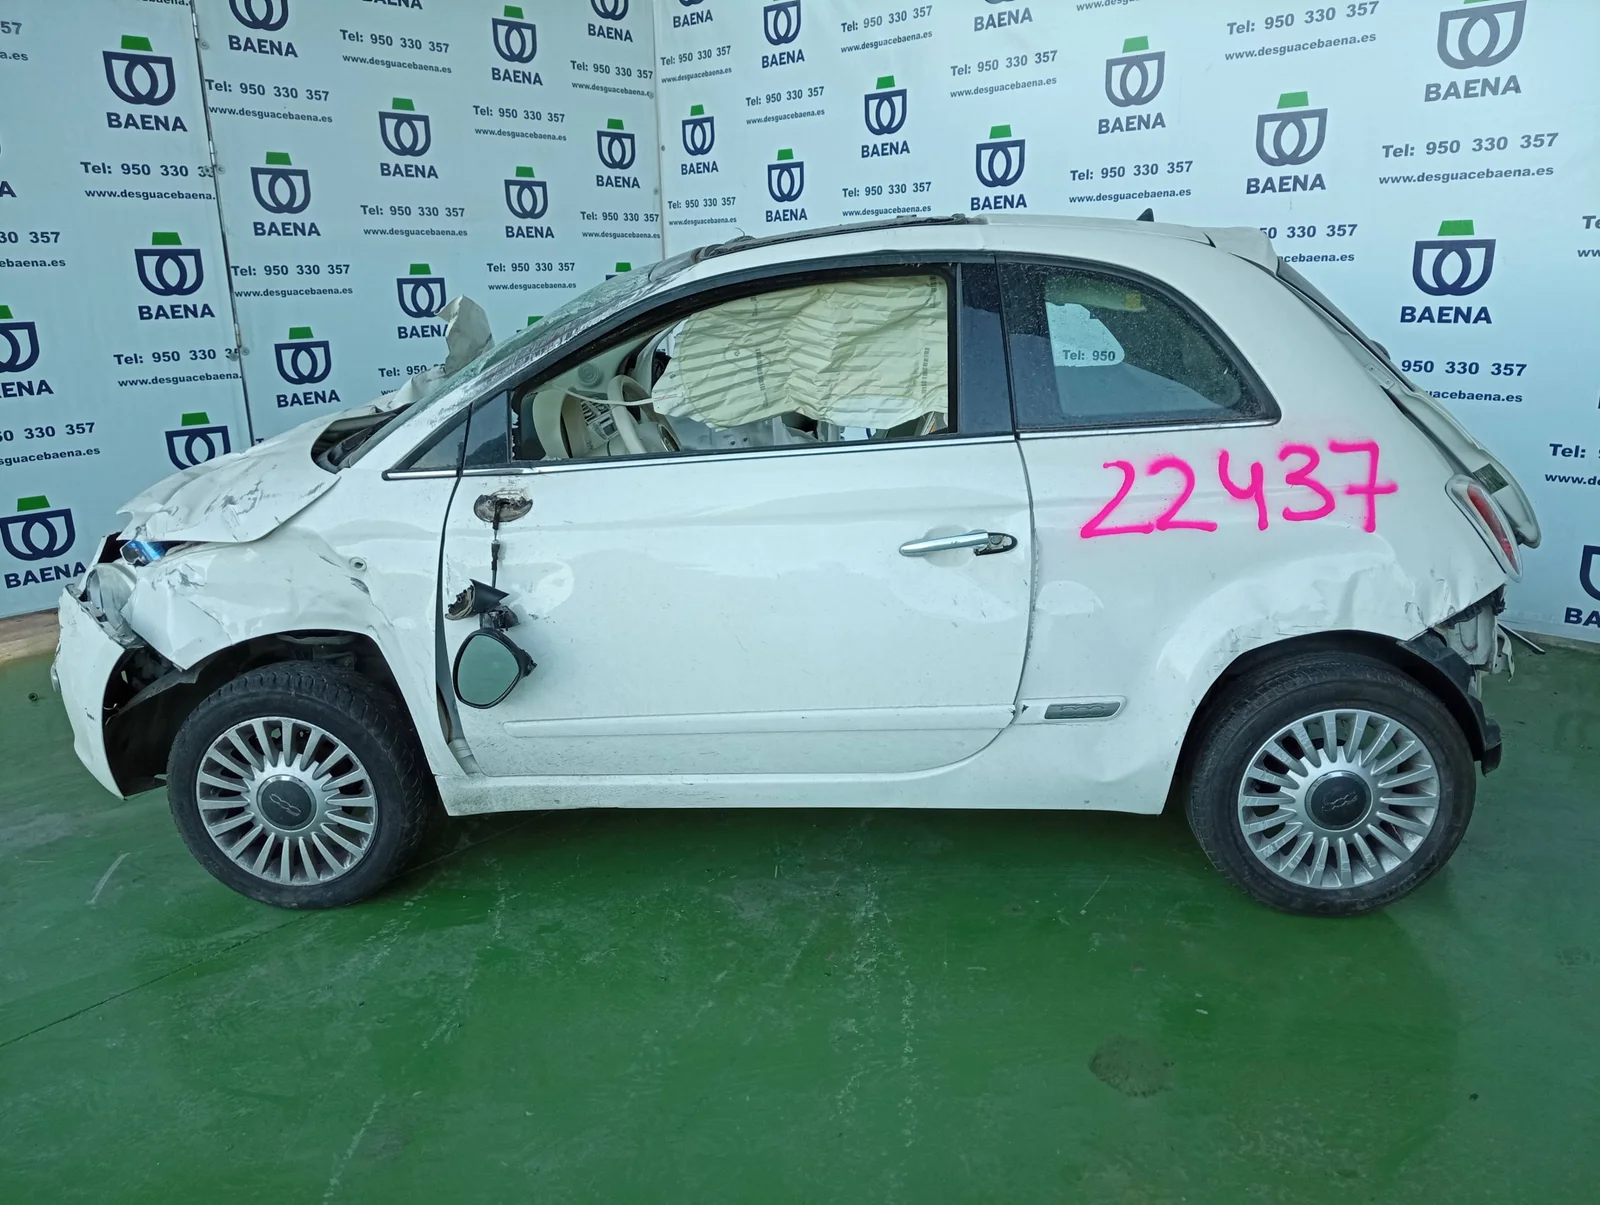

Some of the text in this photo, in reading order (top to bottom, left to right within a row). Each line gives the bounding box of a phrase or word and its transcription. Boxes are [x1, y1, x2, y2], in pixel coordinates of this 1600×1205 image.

[673, 10, 713, 28] BAENA
[841, 5, 932, 32] Tel: 950 330 357
[974, 8, 1033, 31] BAENA
[1227, 1, 1379, 35] Tel: 950 330 357
[588, 23, 633, 42] BAENA
[228, 35, 298, 57] BAENA
[340, 29, 449, 53] Tel: 950 330 357
[841, 30, 932, 53] www.desguacebaena.es
[1225, 32, 1376, 60] www.desguacebaena.es
[660, 45, 731, 65] Tel: 950 330 357
[762, 49, 805, 68] BAENA
[951, 50, 1057, 76] Tel: 950 330 357
[342, 55, 451, 73] www.desguacebaena.es
[570, 60, 653, 79] Tel: 950 330 357
[492, 67, 543, 85] BAENA
[661, 68, 731, 83] www.desguacebaena.es
[205, 79, 329, 101] Tel: 950 330 357
[950, 78, 1056, 97] www.desguacebaena.es
[1425, 75, 1521, 102] BAENA
[746, 86, 824, 106] Tel: 950 330 357
[209, 107, 332, 122] www.desguacebaena.es
[473, 105, 565, 122] Tel: 950 330 357
[746, 110, 825, 124] www.desguacebaena.es
[107, 112, 187, 132] BAENA
[1098, 113, 1166, 134] BAENA
[475, 129, 566, 141] www.desguacebaena.es
[862, 141, 910, 158] BAENA
[1382, 133, 1558, 158] Tel: 950 330 357
[80, 162, 112, 174] Tel:
[121, 163, 150, 175] 950
[160, 165, 188, 176] 330
[380, 163, 438, 178] BAENA
[681, 161, 718, 175] BAENA
[1070, 161, 1193, 181] Tel: 950 330 357
[1379, 168, 1553, 184] www.desguacebaena.es
[596, 175, 640, 188] BAENA
[842, 182, 931, 197] Tel: 950 330 357
[1246, 174, 1326, 194] BAENA
[668, 197, 736, 209] Tel: 950 330 357
[971, 194, 1027, 211] BAENA
[1069, 189, 1191, 203] www.desguacebaena.es
[360, 205, 464, 217] Tel: 950 330 357
[580, 212, 659, 222] Tel: 950 330 357
[766, 208, 807, 222] BAENA
[842, 205, 932, 217] www.desguacebaena.es
[253, 222, 321, 236] BAENA
[669, 218, 736, 226] www.desguacebaena.es
[29, 232, 60, 243] 357
[363, 228, 467, 237] www.desguacebaena.es
[506, 226, 554, 238] BAENA
[582, 231, 660, 239] www.desguacebaena.es
[1287, 226, 1316, 238] 330
[1326, 224, 1357, 237] 357
[231, 265, 349, 276] Tel: 950 330 357
[487, 263, 575, 272] Tel: 950 330 357
[234, 287, 353, 298] www.desguacebaena.es
[488, 282, 576, 291] www.desguacebaena.es
[138, 304, 215, 320] BAENA
[1400, 306, 1492, 324] BAENA
[113, 354, 143, 365] Tel:
[152, 351, 180, 362] 950
[189, 349, 216, 360] 330
[1063, 350, 1115, 361] Tel: 950
[378, 368, 400, 377] Tel:
[1402, 360, 1527, 376] 950 330 357
[0, 380, 54, 398] ENA
[276, 390, 340, 408] BAENA
[24, 426, 55, 439] 330
[65, 422, 94, 435] 357
[1549, 444, 1585, 458] Tel:
[1080, 440, 1396, 539] 22437
[4, 561, 87, 588] BAENA
